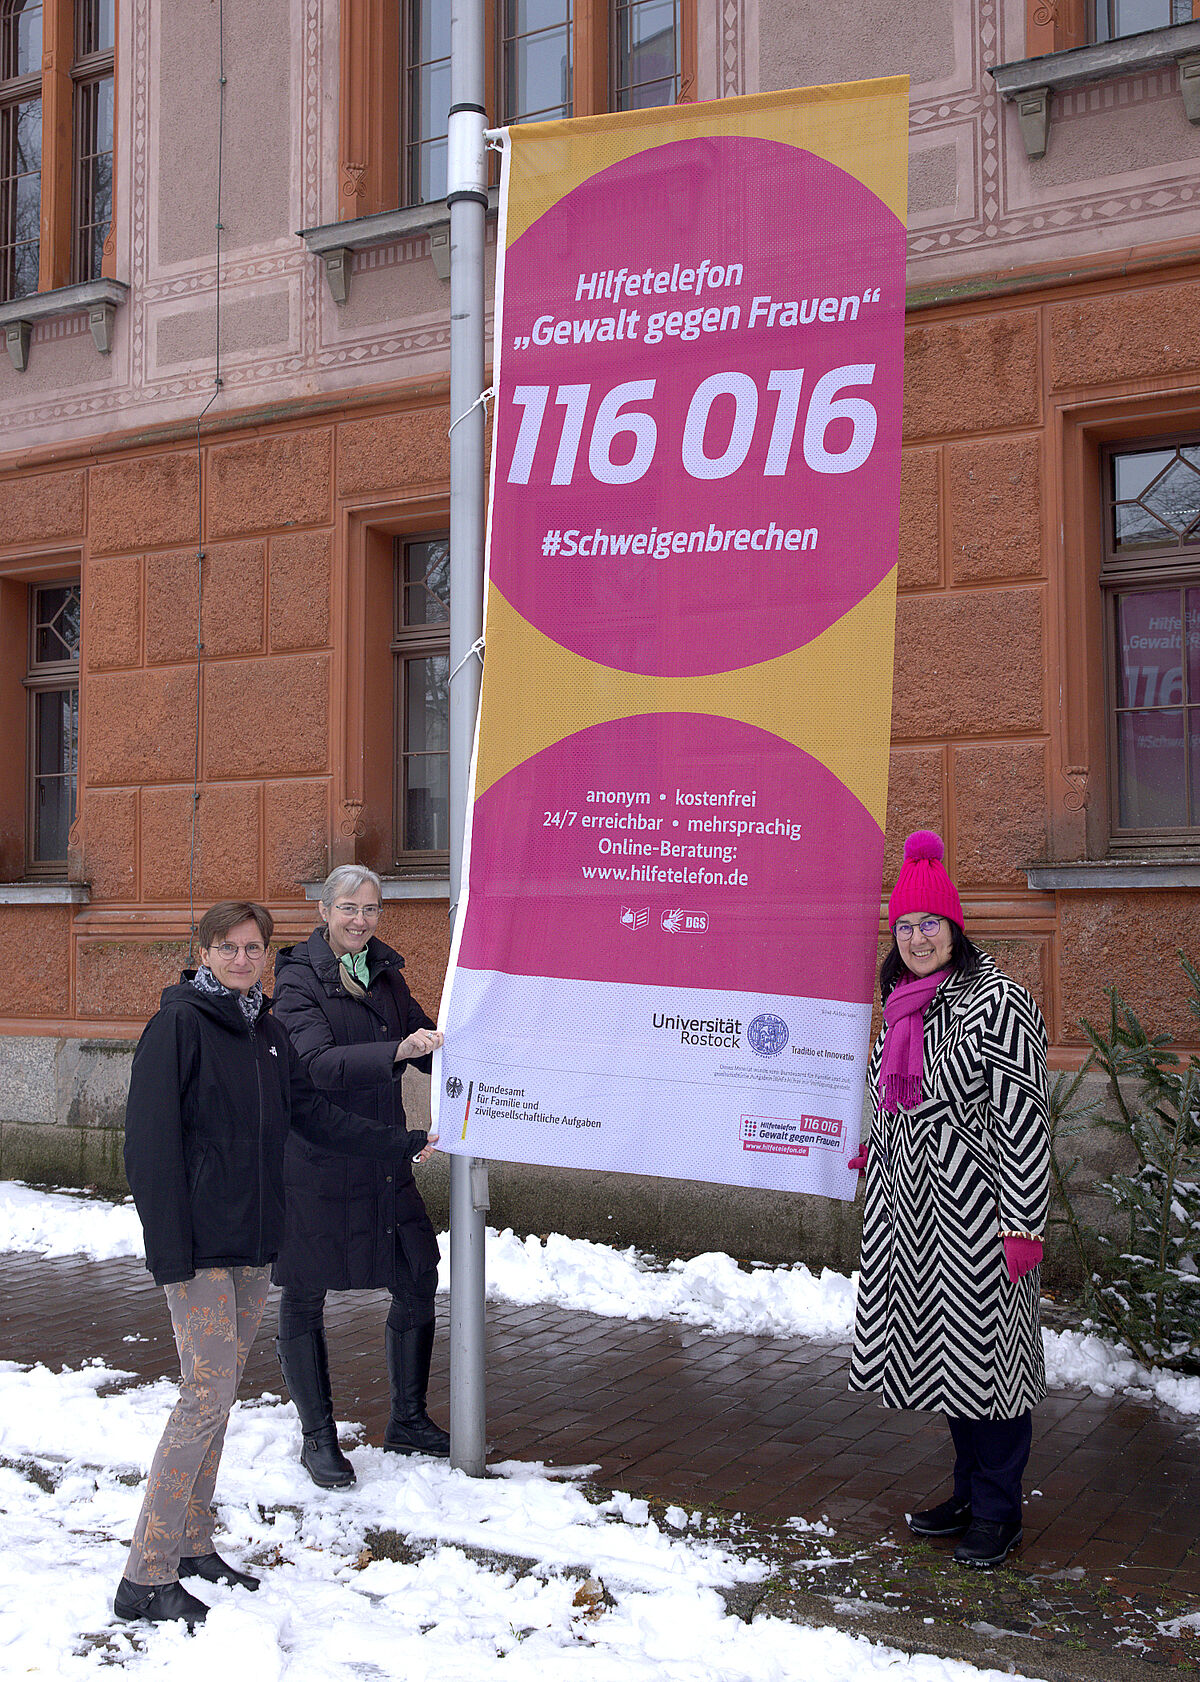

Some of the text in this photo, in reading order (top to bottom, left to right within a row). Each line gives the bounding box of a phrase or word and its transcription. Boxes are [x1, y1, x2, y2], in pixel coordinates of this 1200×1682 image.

[574, 260, 744, 303] Hilfetelefon
[513, 287, 881, 350] „Gewalt gegen Frauen“
[506, 363, 878, 486] 116 016
[541, 522, 819, 560] #Schweigenbrechen
[1125, 666, 1189, 716] 116
[586, 789, 757, 808] anonym kostenfrei
[543, 810, 802, 841] 24/7 erreichbar mehrsprachig
[598, 838, 738, 862] Online-Beratung:
[581, 864, 749, 886] www.hilfetelefon.de
[685, 916, 706, 930] DGS
[652, 1013, 742, 1035] Universität
[680, 1031, 741, 1049] Rostock
[791, 1045, 816, 1056] Traditio
[816, 1049, 824, 1058] et
[824, 1049, 855, 1062] Innovatio
[478, 1082, 525, 1097] Bundesamt
[476, 1094, 539, 1110] für Familie und
[475, 1107, 602, 1129] zivilgesellschaftliche Aufgaben
[760, 1122, 796, 1131] Hilfetelefon
[803, 1118, 838, 1133] 116 016
[745, 1142, 807, 1154] www.hilfetelefon.de
[759, 1129, 840, 1147] Gewalt gegen Frauen
